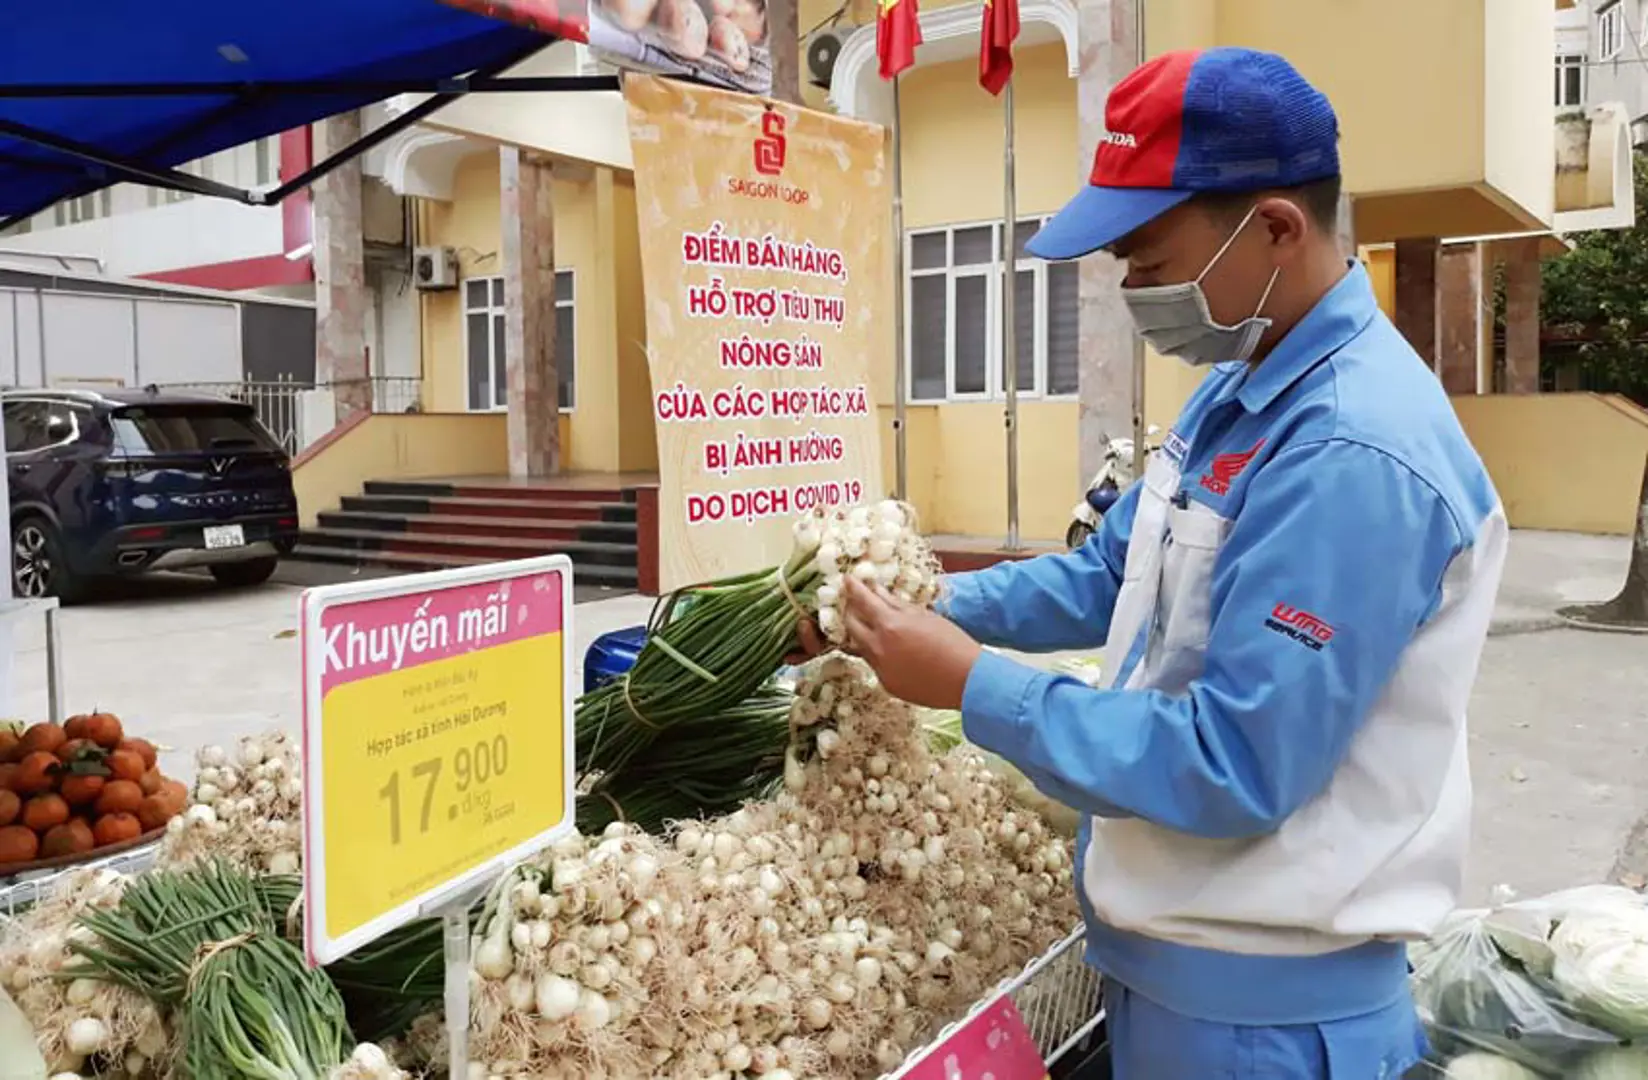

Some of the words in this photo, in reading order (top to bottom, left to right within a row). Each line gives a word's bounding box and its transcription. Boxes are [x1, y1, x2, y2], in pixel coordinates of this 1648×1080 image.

[728, 178, 778, 199] SAIGON
[684, 223, 741, 265] ĐIỂM
[690, 279, 726, 315] HỖ
[732, 289, 776, 323] TRỢ
[814, 298, 844, 328] THỤ
[721, 336, 791, 367] NÔNG
[794, 335, 822, 367] SẢN
[658, 384, 706, 419] CỦA
[713, 385, 764, 416] CÁC
[811, 385, 841, 414] TÁC
[846, 387, 868, 413] XÃ
[706, 442, 727, 475] BỊ
[734, 434, 782, 466] ẢNH
[688, 495, 725, 522] DO
[732, 489, 788, 522] DỊCH
[795, 484, 840, 510] COVID
[844, 481, 861, 504] 19
[321, 597, 448, 675] Khuyến
[457, 593, 509, 643] mãi
